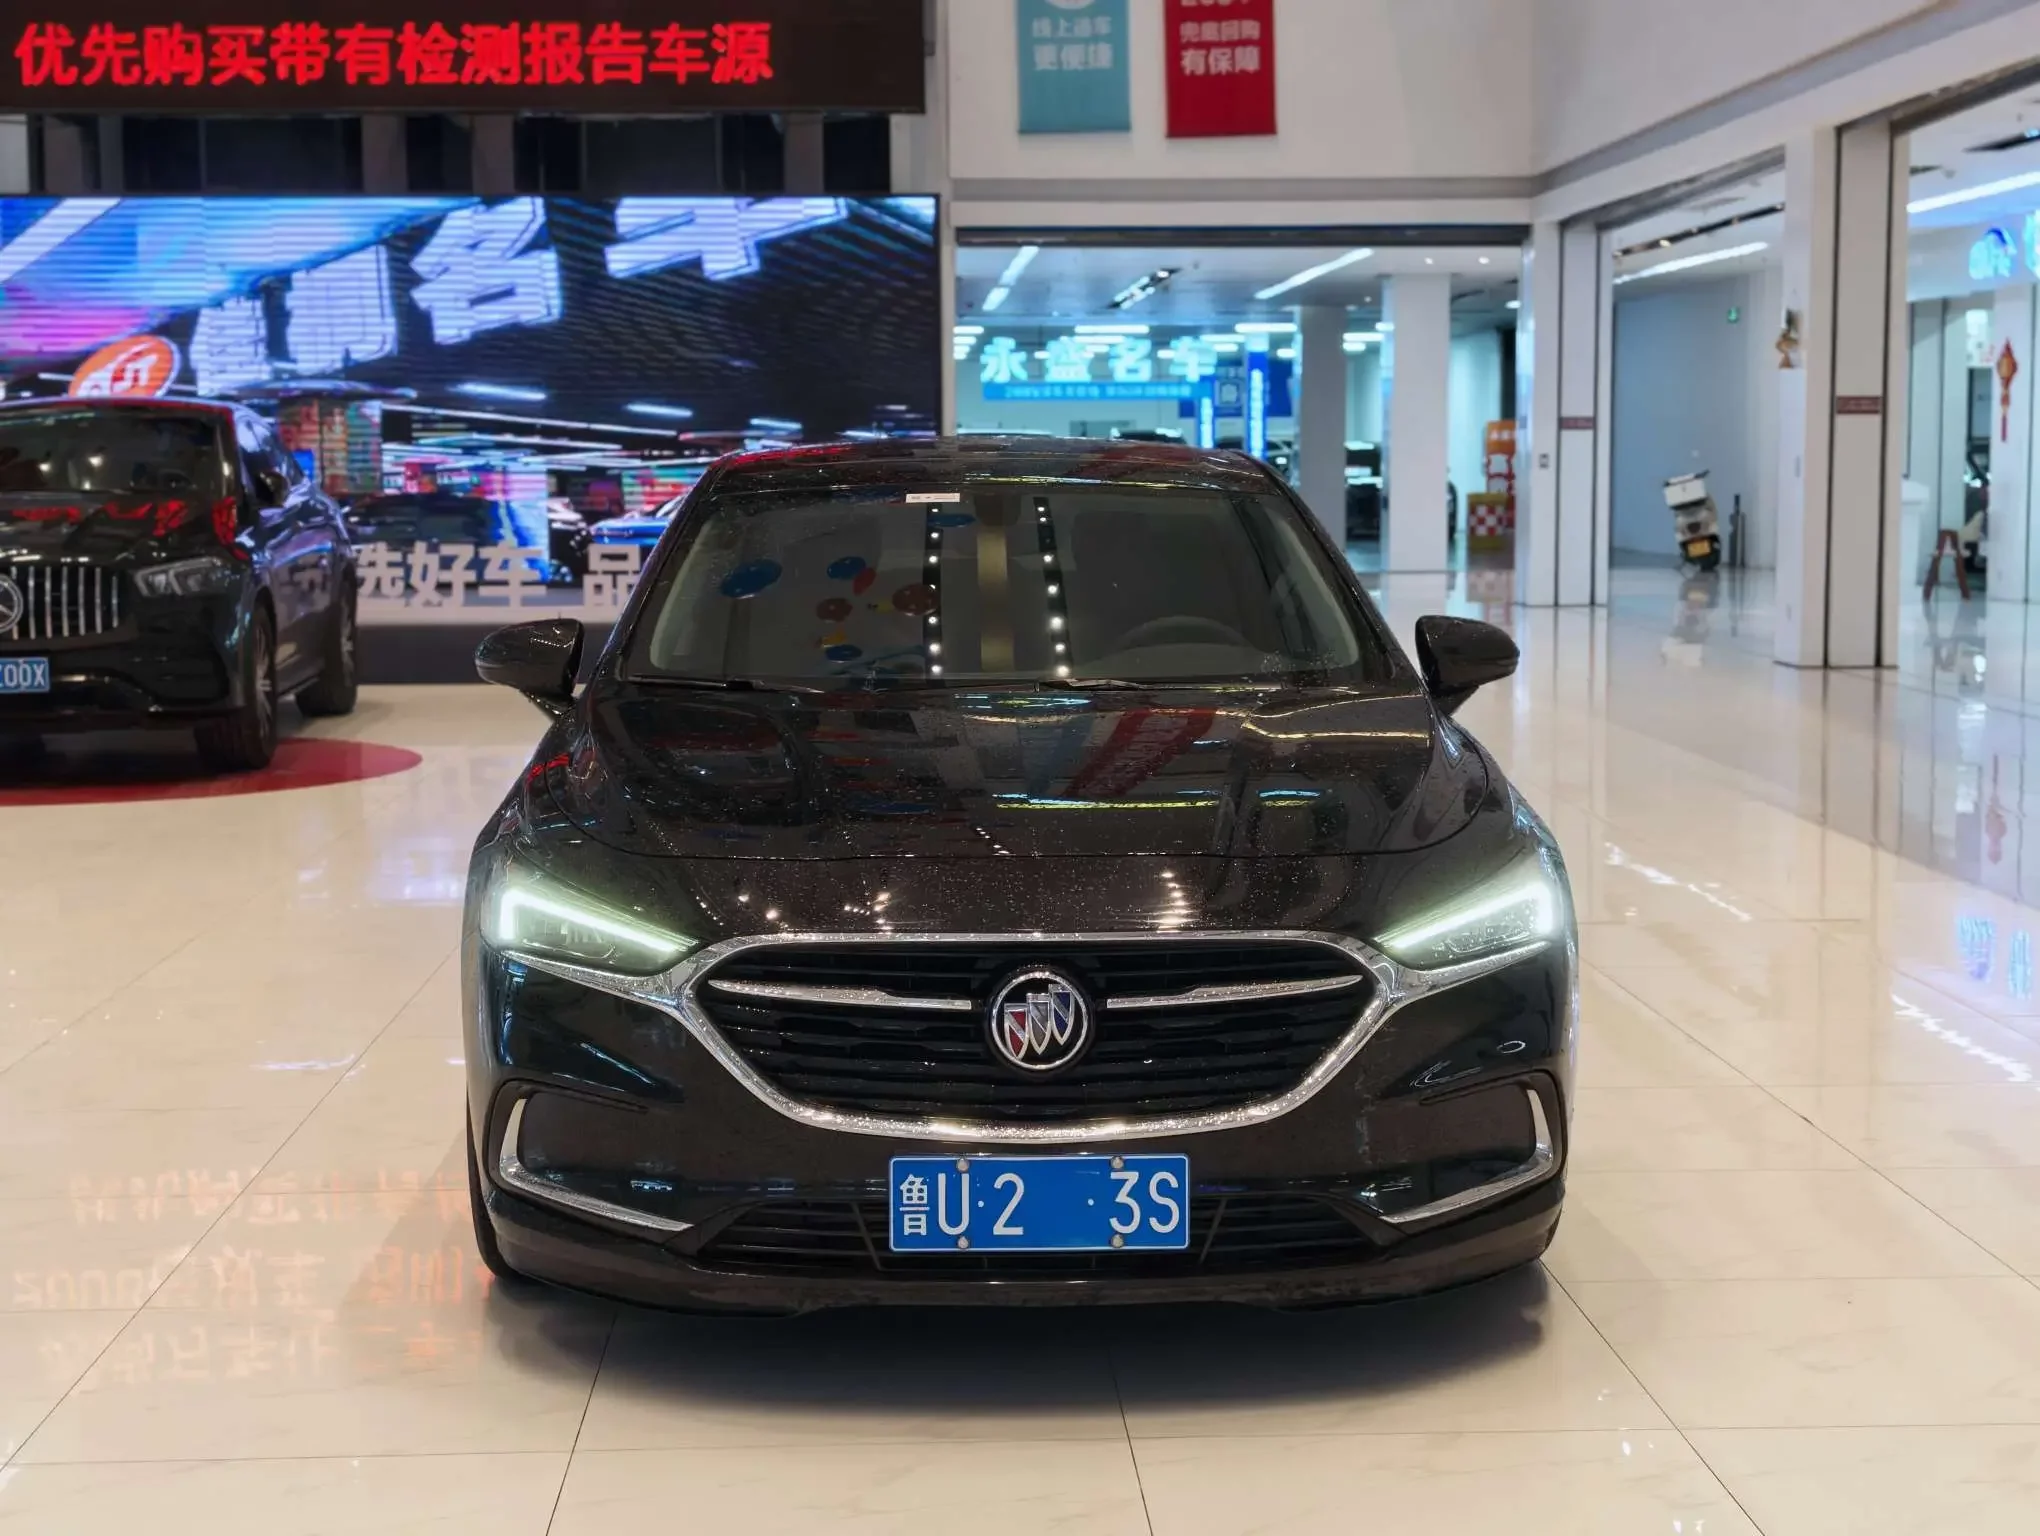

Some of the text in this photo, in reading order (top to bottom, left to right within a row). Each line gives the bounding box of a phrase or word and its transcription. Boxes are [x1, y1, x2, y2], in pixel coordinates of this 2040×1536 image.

[14, 22, 774, 85] 优先购买带有检测报告车源
[1180, 46, 1261, 76] 有保障
[0, 664, 45, 687] 00X
